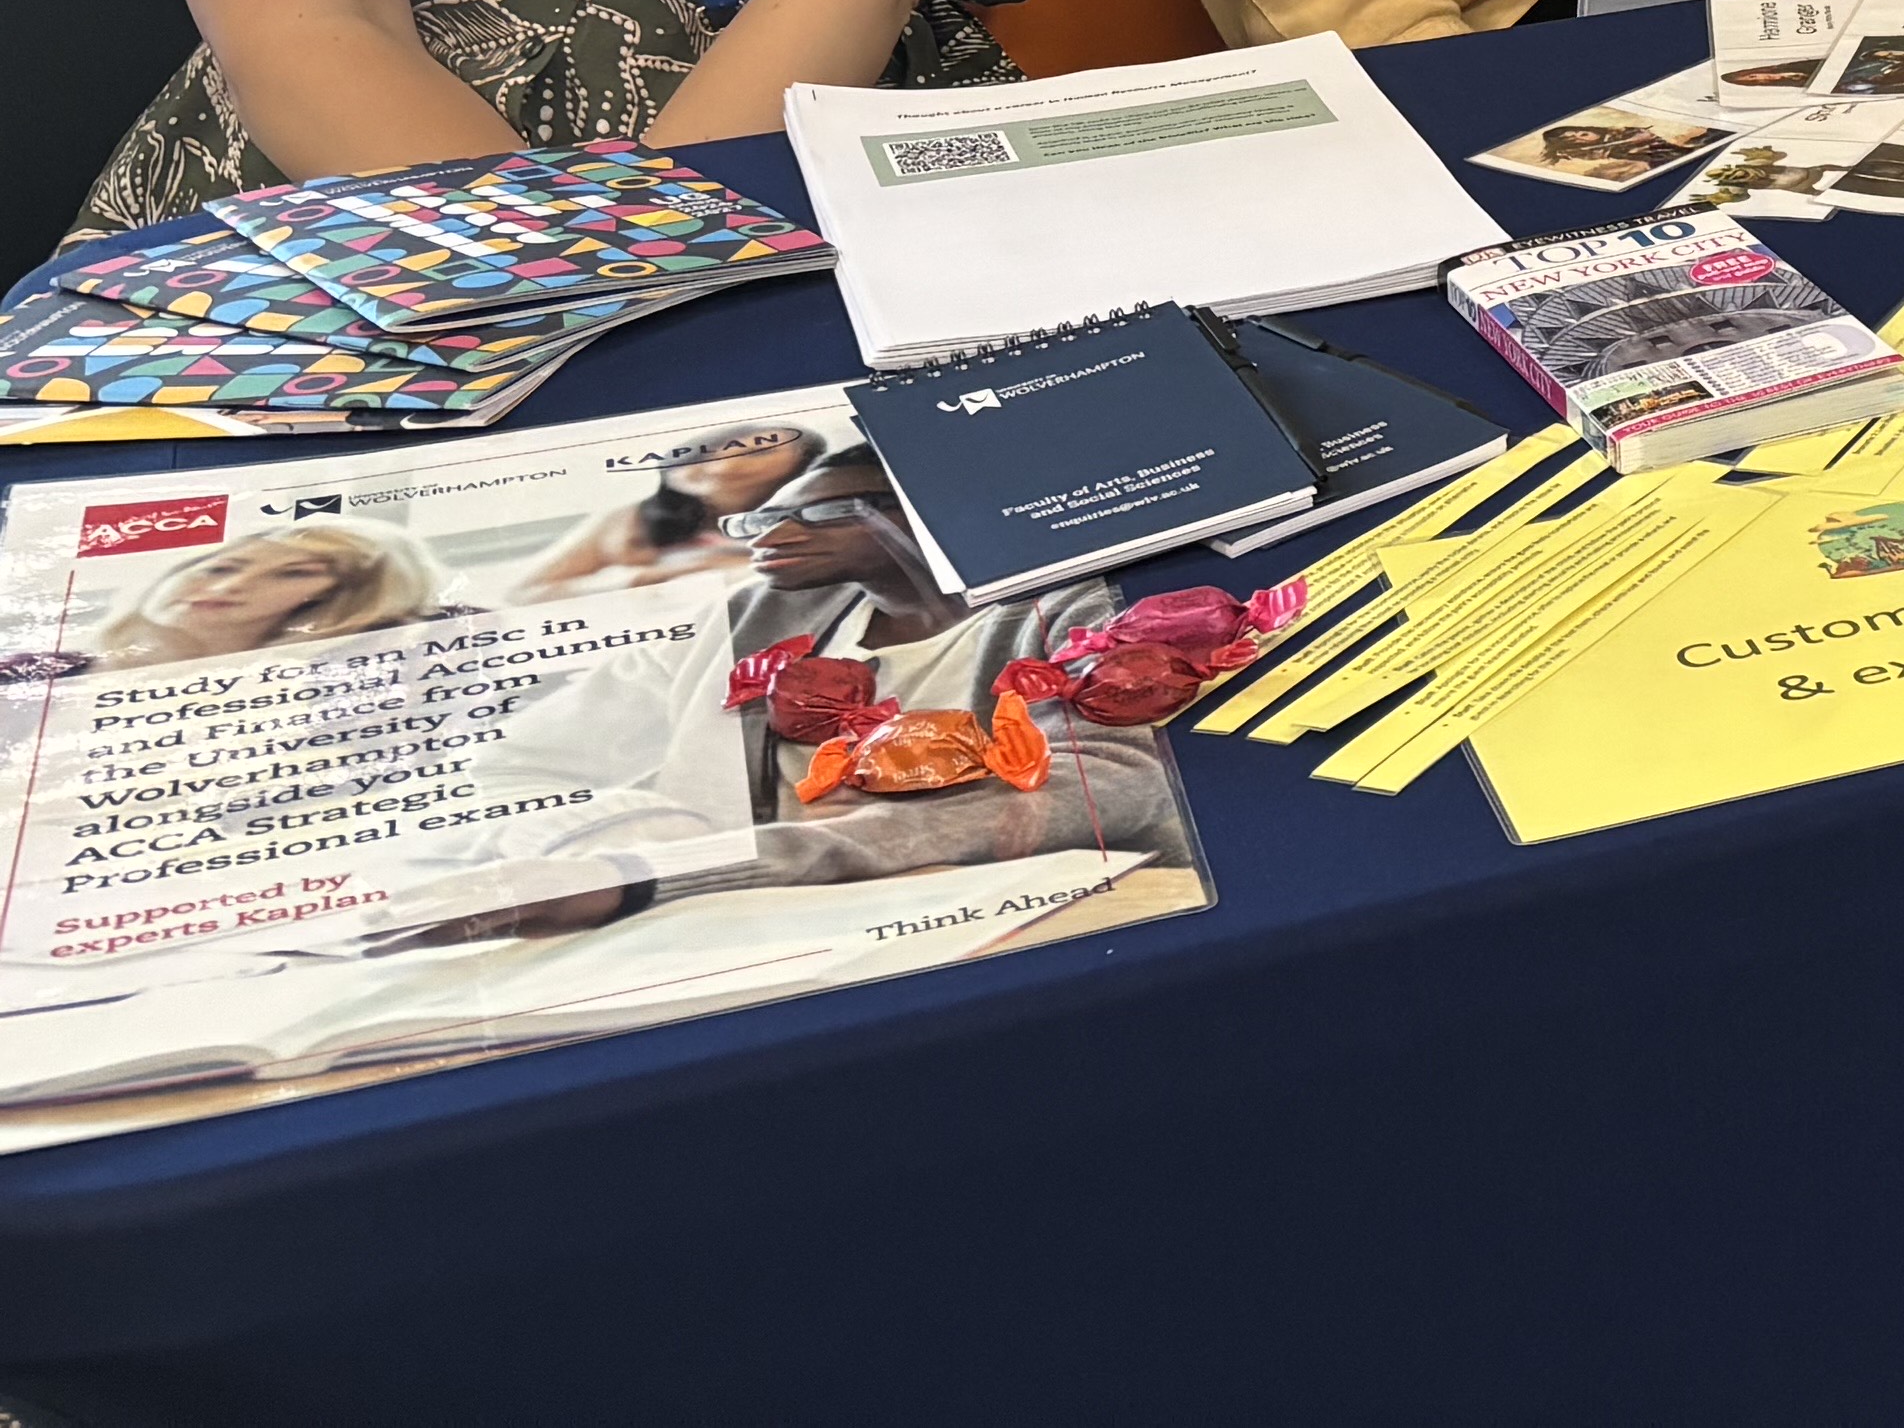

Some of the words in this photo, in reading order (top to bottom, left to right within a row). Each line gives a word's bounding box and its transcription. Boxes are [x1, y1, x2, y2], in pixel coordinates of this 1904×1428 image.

[896, 111, 950, 121] Thought
[952, 106, 991, 115] about
[1004, 100, 1046, 110] career
[1170, 69, 1258, 89] Management?
[1493, 238, 1608, 273] TOP
[1619, 220, 1698, 249] 10
[1511, 221, 1630, 251] EYEWITNESS
[1635, 205, 1701, 226] TRAVEL
[1480, 270, 1572, 303] NEW
[1573, 248, 1668, 277] YORK
[1673, 231, 1748, 256] CITY
[1703, 254, 1753, 271] FREE
[997, 350, 1146, 401] WOLVERHAMPTON
[605, 432, 784, 470] KAPLAN
[1002, 489, 1069, 517] Faculty
[1072, 482, 1091, 497] of
[1094, 471, 1136, 495] Arts,
[1138, 448, 1215, 477] Business
[347, 468, 568, 509] WOLVERHAMPTON
[1030, 501, 1063, 519] and
[1067, 485, 1120, 510] Social
[1124, 463, 1201, 494] Sciences
[86, 510, 219, 542] ACCA
[90, 669, 402, 733] Professional
[416, 620, 698, 683] Accounting
[95, 673, 237, 711] Study
[259, 657, 338, 685] for
[344, 648, 407, 671] an
[424, 626, 528, 658] MSc
[541, 614, 588, 636] in
[1777, 673, 1836, 703] &
[81, 758, 169, 787] the
[186, 710, 450, 771] University
[466, 695, 519, 720] of
[87, 727, 185, 761] and
[208, 692, 405, 741] Finance
[421, 668, 541, 704] from
[72, 784, 334, 839] alongside
[347, 756, 474, 795] your
[81, 725, 508, 810] Wolverhampton
[61, 820, 402, 895] Professional
[419, 788, 595, 832] exams
[65, 828, 224, 867] ACCA
[245, 780, 477, 837] Strategic
[49, 916, 220, 958] experts
[235, 888, 389, 929] Kaplan
[54, 883, 286, 935] Supported
[301, 871, 354, 898] by
[866, 906, 985, 941] Think
[994, 877, 1118, 917] Ahead
